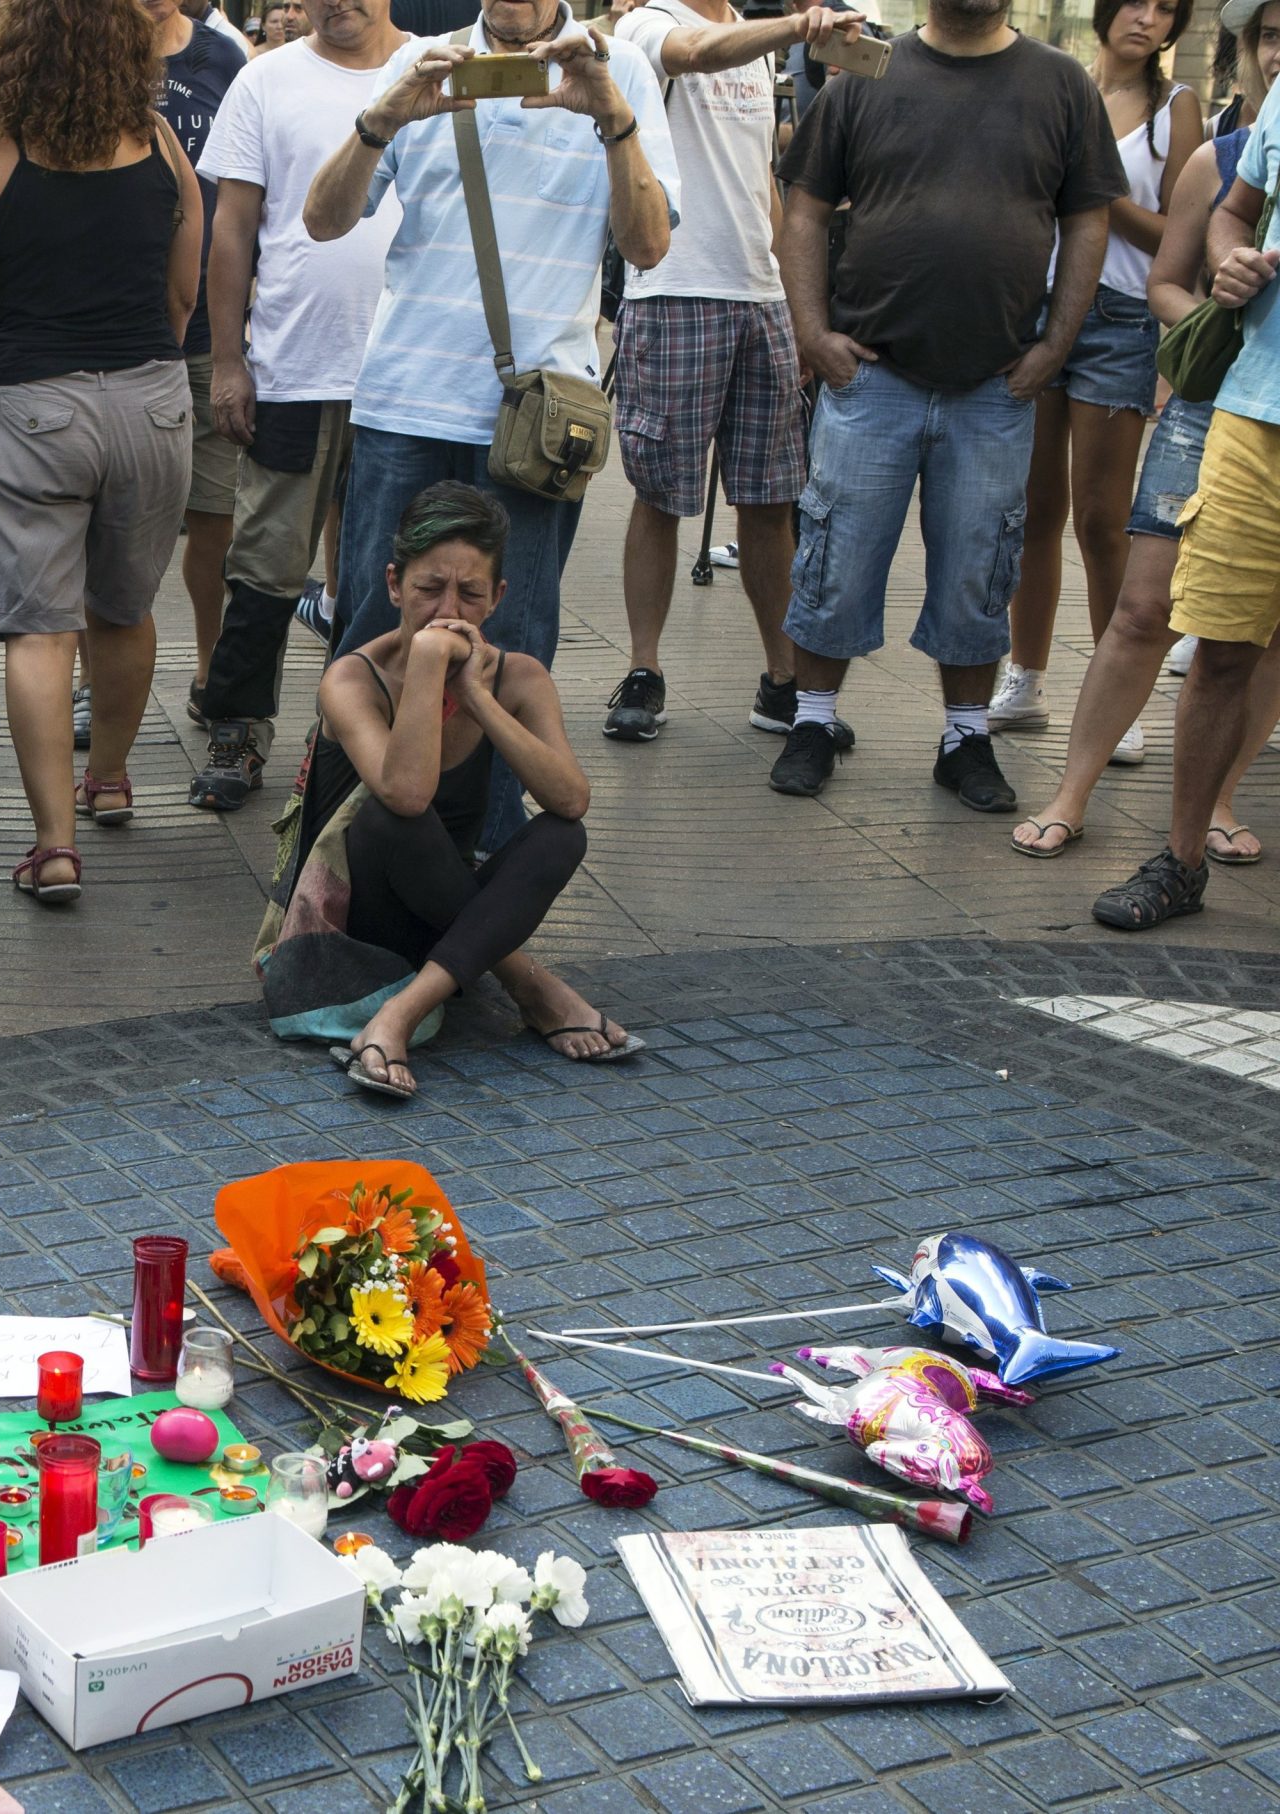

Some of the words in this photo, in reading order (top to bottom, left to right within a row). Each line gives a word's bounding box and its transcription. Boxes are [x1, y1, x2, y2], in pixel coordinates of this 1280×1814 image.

[167, 79, 193, 99] TIME
[755, 1531, 798, 1541] SINCE
[686, 1555, 866, 1572] CATALONIA
[771, 1572, 797, 1585] of
[740, 1584, 846, 1597] CAPITAL
[767, 1606, 855, 1626] Edition
[792, 1625, 842, 1634] LIMITED
[288, 1647, 353, 1673] VISION
[740, 1641, 937, 1679] BARCELONA
[273, 1657, 353, 1688] DASOON
